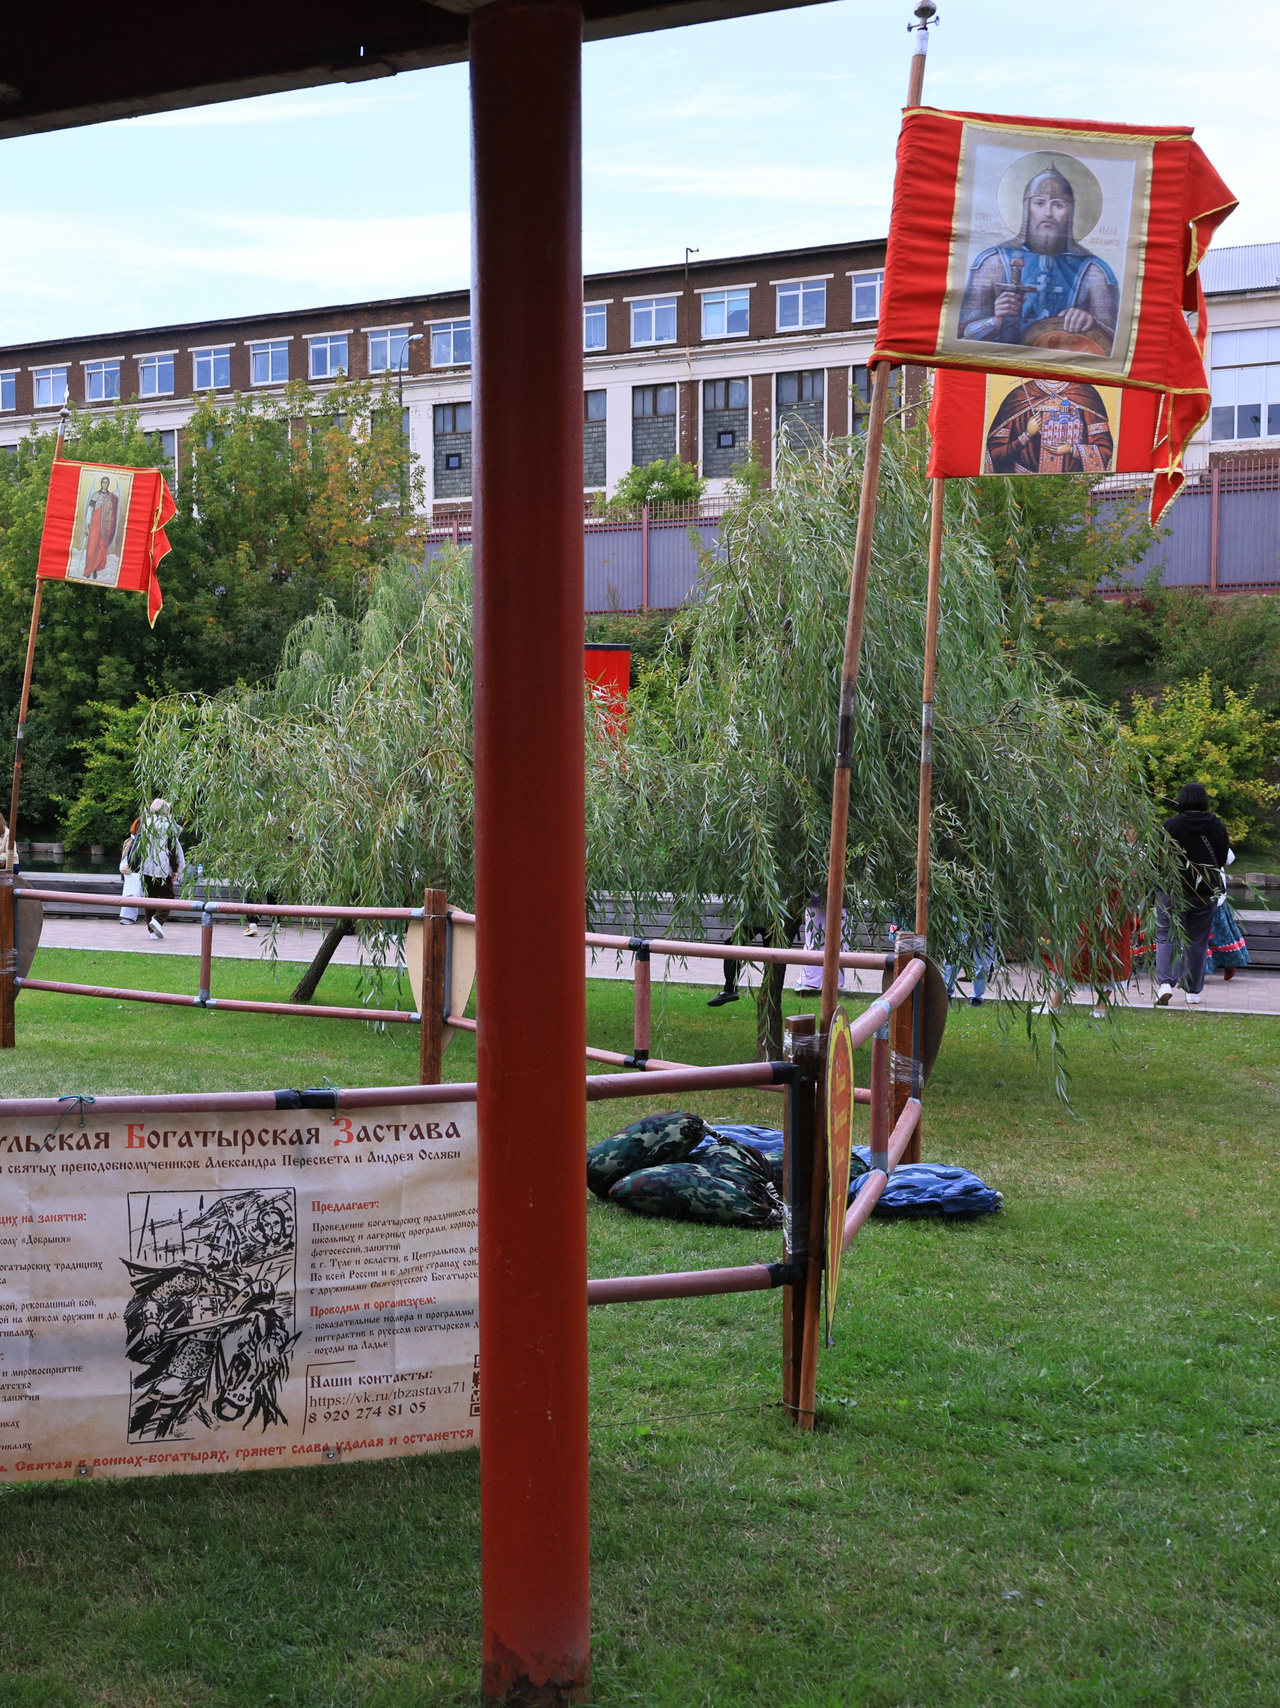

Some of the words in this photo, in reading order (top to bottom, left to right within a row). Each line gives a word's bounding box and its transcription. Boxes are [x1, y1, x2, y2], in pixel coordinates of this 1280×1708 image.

[125, 1123, 320, 1155] Богатырская
[333, 1118, 461, 1147] Застава
[8, 1164, 56, 1176] святых
[61, 1159, 200, 1175] преподобномучеников
[205, 1156, 277, 1170] Александра
[282, 1154, 350, 1169] Пересвета
[355, 1154, 362, 1163] и
[368, 1151, 414, 1165] Андрея
[419, 1149, 461, 1161] Осляби
[311, 1200, 380, 1214] Предлагает:
[22, 1214, 34, 1223] на
[38, 1213, 87, 1224] занятия:
[312, 1221, 364, 1233] Проведение
[367, 1215, 421, 1228] богатырских
[21, 1235, 71, 1246] «Добрыня»
[311, 1234, 355, 1245] школьных
[358, 1233, 363, 1241] и
[366, 1230, 406, 1242] лагерных
[54, 1261, 103, 1271] традициях
[311, 1261, 316, 1269] в
[319, 1260, 326, 1268] г.
[329, 1258, 352, 1269] Туле
[363, 1255, 400, 1265] области,
[412, 1247, 466, 1261] Центральном
[310, 1273, 323, 1282] По
[325, 1271, 345, 1281] всей
[349, 1269, 379, 1280] России
[398, 1264, 424, 1277] других
[426, 1260, 460, 1270] странах
[317, 1284, 367, 1296] дружинами
[370, 1275, 428, 1290] Святорусского
[0, 1302, 18, 1311] бой,
[21, 1299, 75, 1312] рукопашный
[78, 1298, 97, 1307] бой,
[309, 1304, 360, 1317] Проводим
[373, 1296, 436, 1312] организуем:
[25, 1314, 59, 1323] мягком
[62, 1312, 94, 1323] оружии
[106, 1311, 120, 1321] др.
[315, 1317, 381, 1330] показательные
[384, 1313, 414, 1325] номера
[417, 1312, 422, 1320] и
[425, 1309, 474, 1321] программы
[315, 1330, 366, 1343] интерактив
[377, 1326, 411, 1338] русском
[414, 1322, 471, 1333] богатырском
[314, 1345, 345, 1356] походы
[347, 1343, 358, 1351] на
[361, 1340, 389, 1351] Ладье
[11, 1365, 83, 1377] мировосприятие
[310, 1374, 352, 1388] Наши
[358, 1370, 433, 1386] контакты:
[309, 1381, 466, 1409] https://vk.ru/tbzastava71
[308, 1412, 317, 1424] 8
[323, 1409, 350, 1423] 920
[356, 1405, 382, 1419] 274
[388, 1404, 402, 1416] 81
[410, 1401, 426, 1413] 05
[15, 1460, 72, 1471] Святая
[93, 1450, 230, 1467] воинах-богатырях,
[235, 1445, 286, 1461] грянет
[292, 1442, 329, 1454] слава
[336, 1437, 384, 1454] удалая
[389, 1436, 397, 1446] и
[402, 1429, 474, 1444] останется
